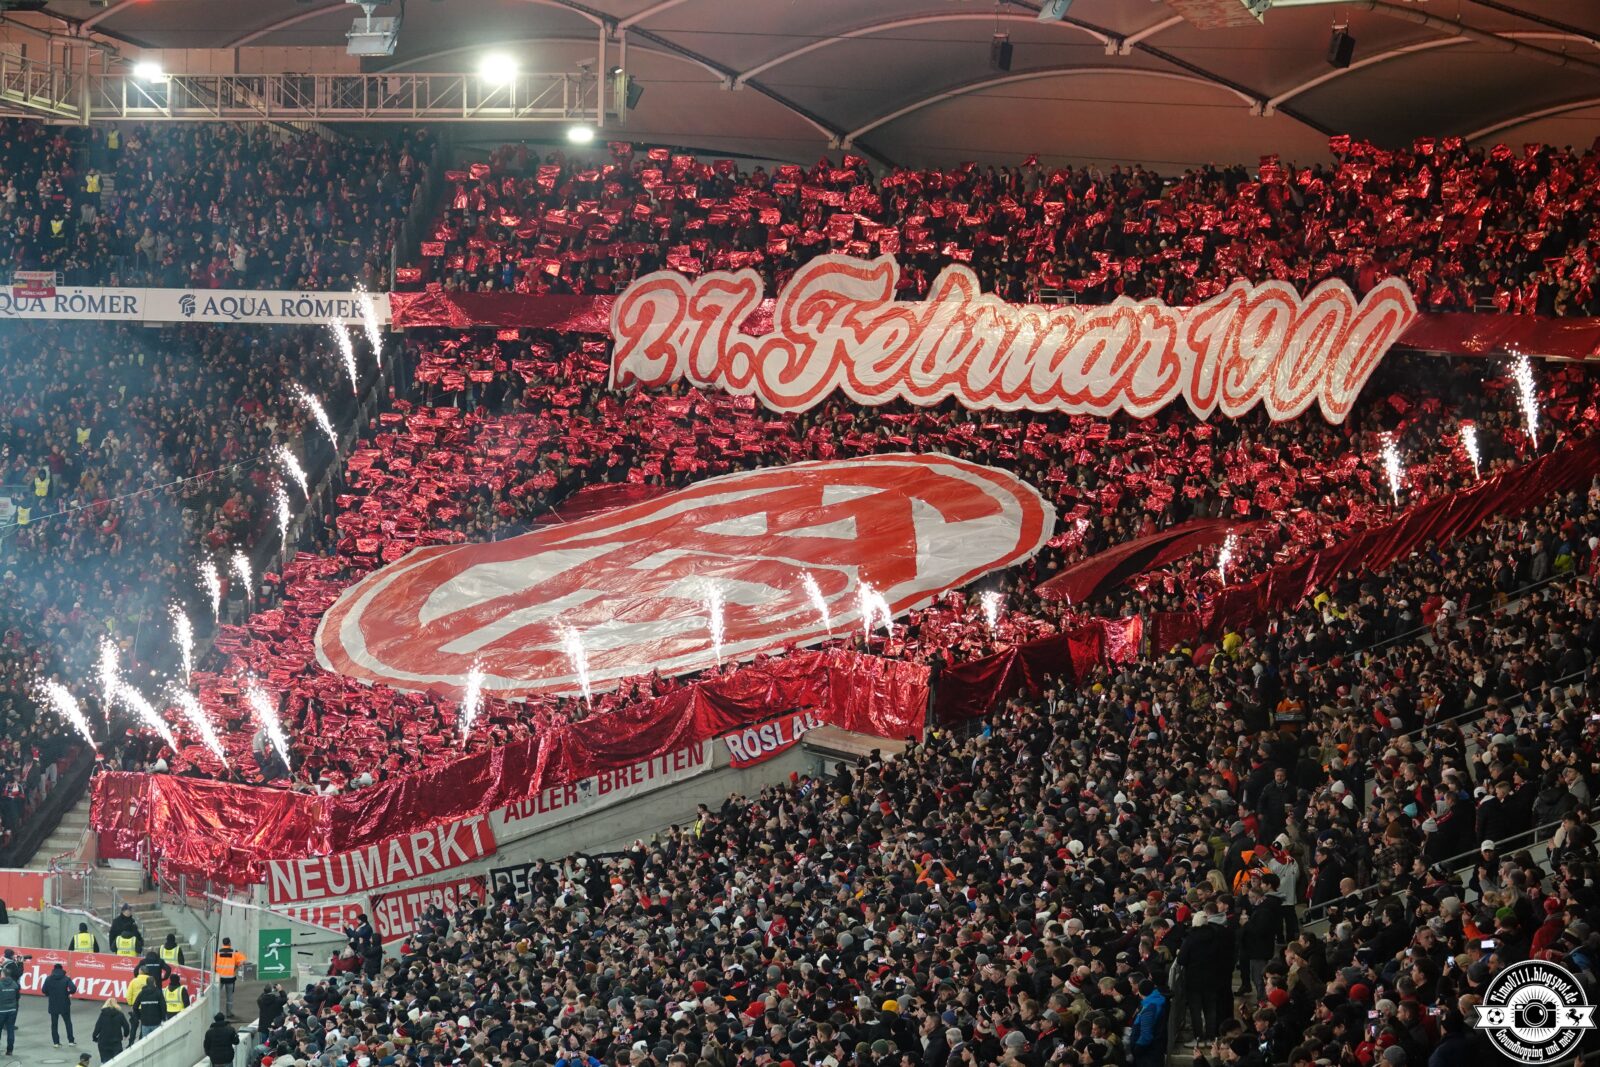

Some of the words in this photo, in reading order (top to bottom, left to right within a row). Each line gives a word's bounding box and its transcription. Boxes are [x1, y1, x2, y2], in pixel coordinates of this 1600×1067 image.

[54, 290, 138, 313] RÖMER
[202, 296, 273, 320] AQUA
[280, 294, 365, 318] RÖMER
[610, 270, 761, 397] 27.
[754, 252, 1182, 414] Februar
[1182, 277, 1416, 424] 1900
[503, 782, 578, 824] ADLER
[269, 813, 486, 902] NEUMARKT
